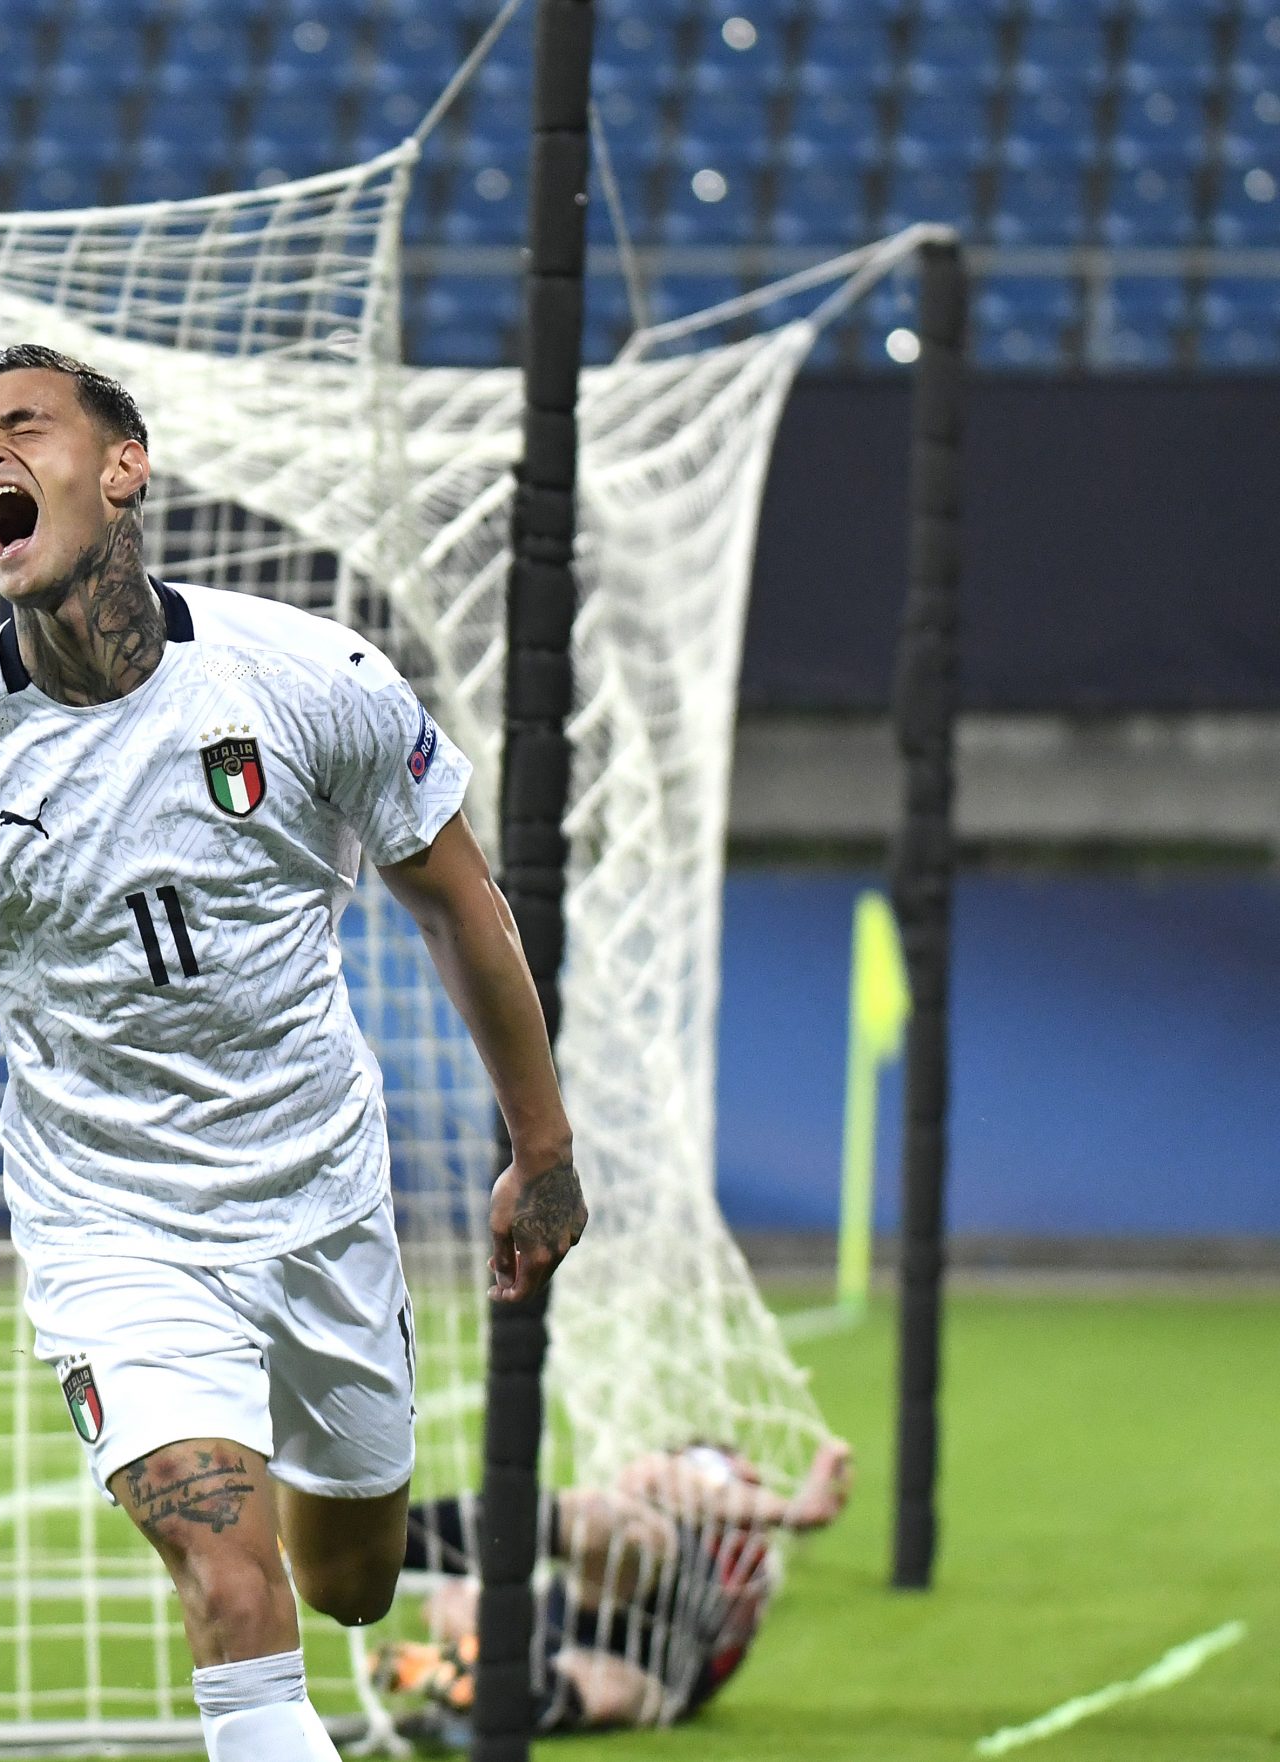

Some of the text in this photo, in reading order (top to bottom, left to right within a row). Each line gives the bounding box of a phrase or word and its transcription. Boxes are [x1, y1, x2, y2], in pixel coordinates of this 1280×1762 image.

[207, 743, 253, 762] ITALIA
[125, 886, 200, 987] 11
[65, 1370, 90, 1396] ITALIA
